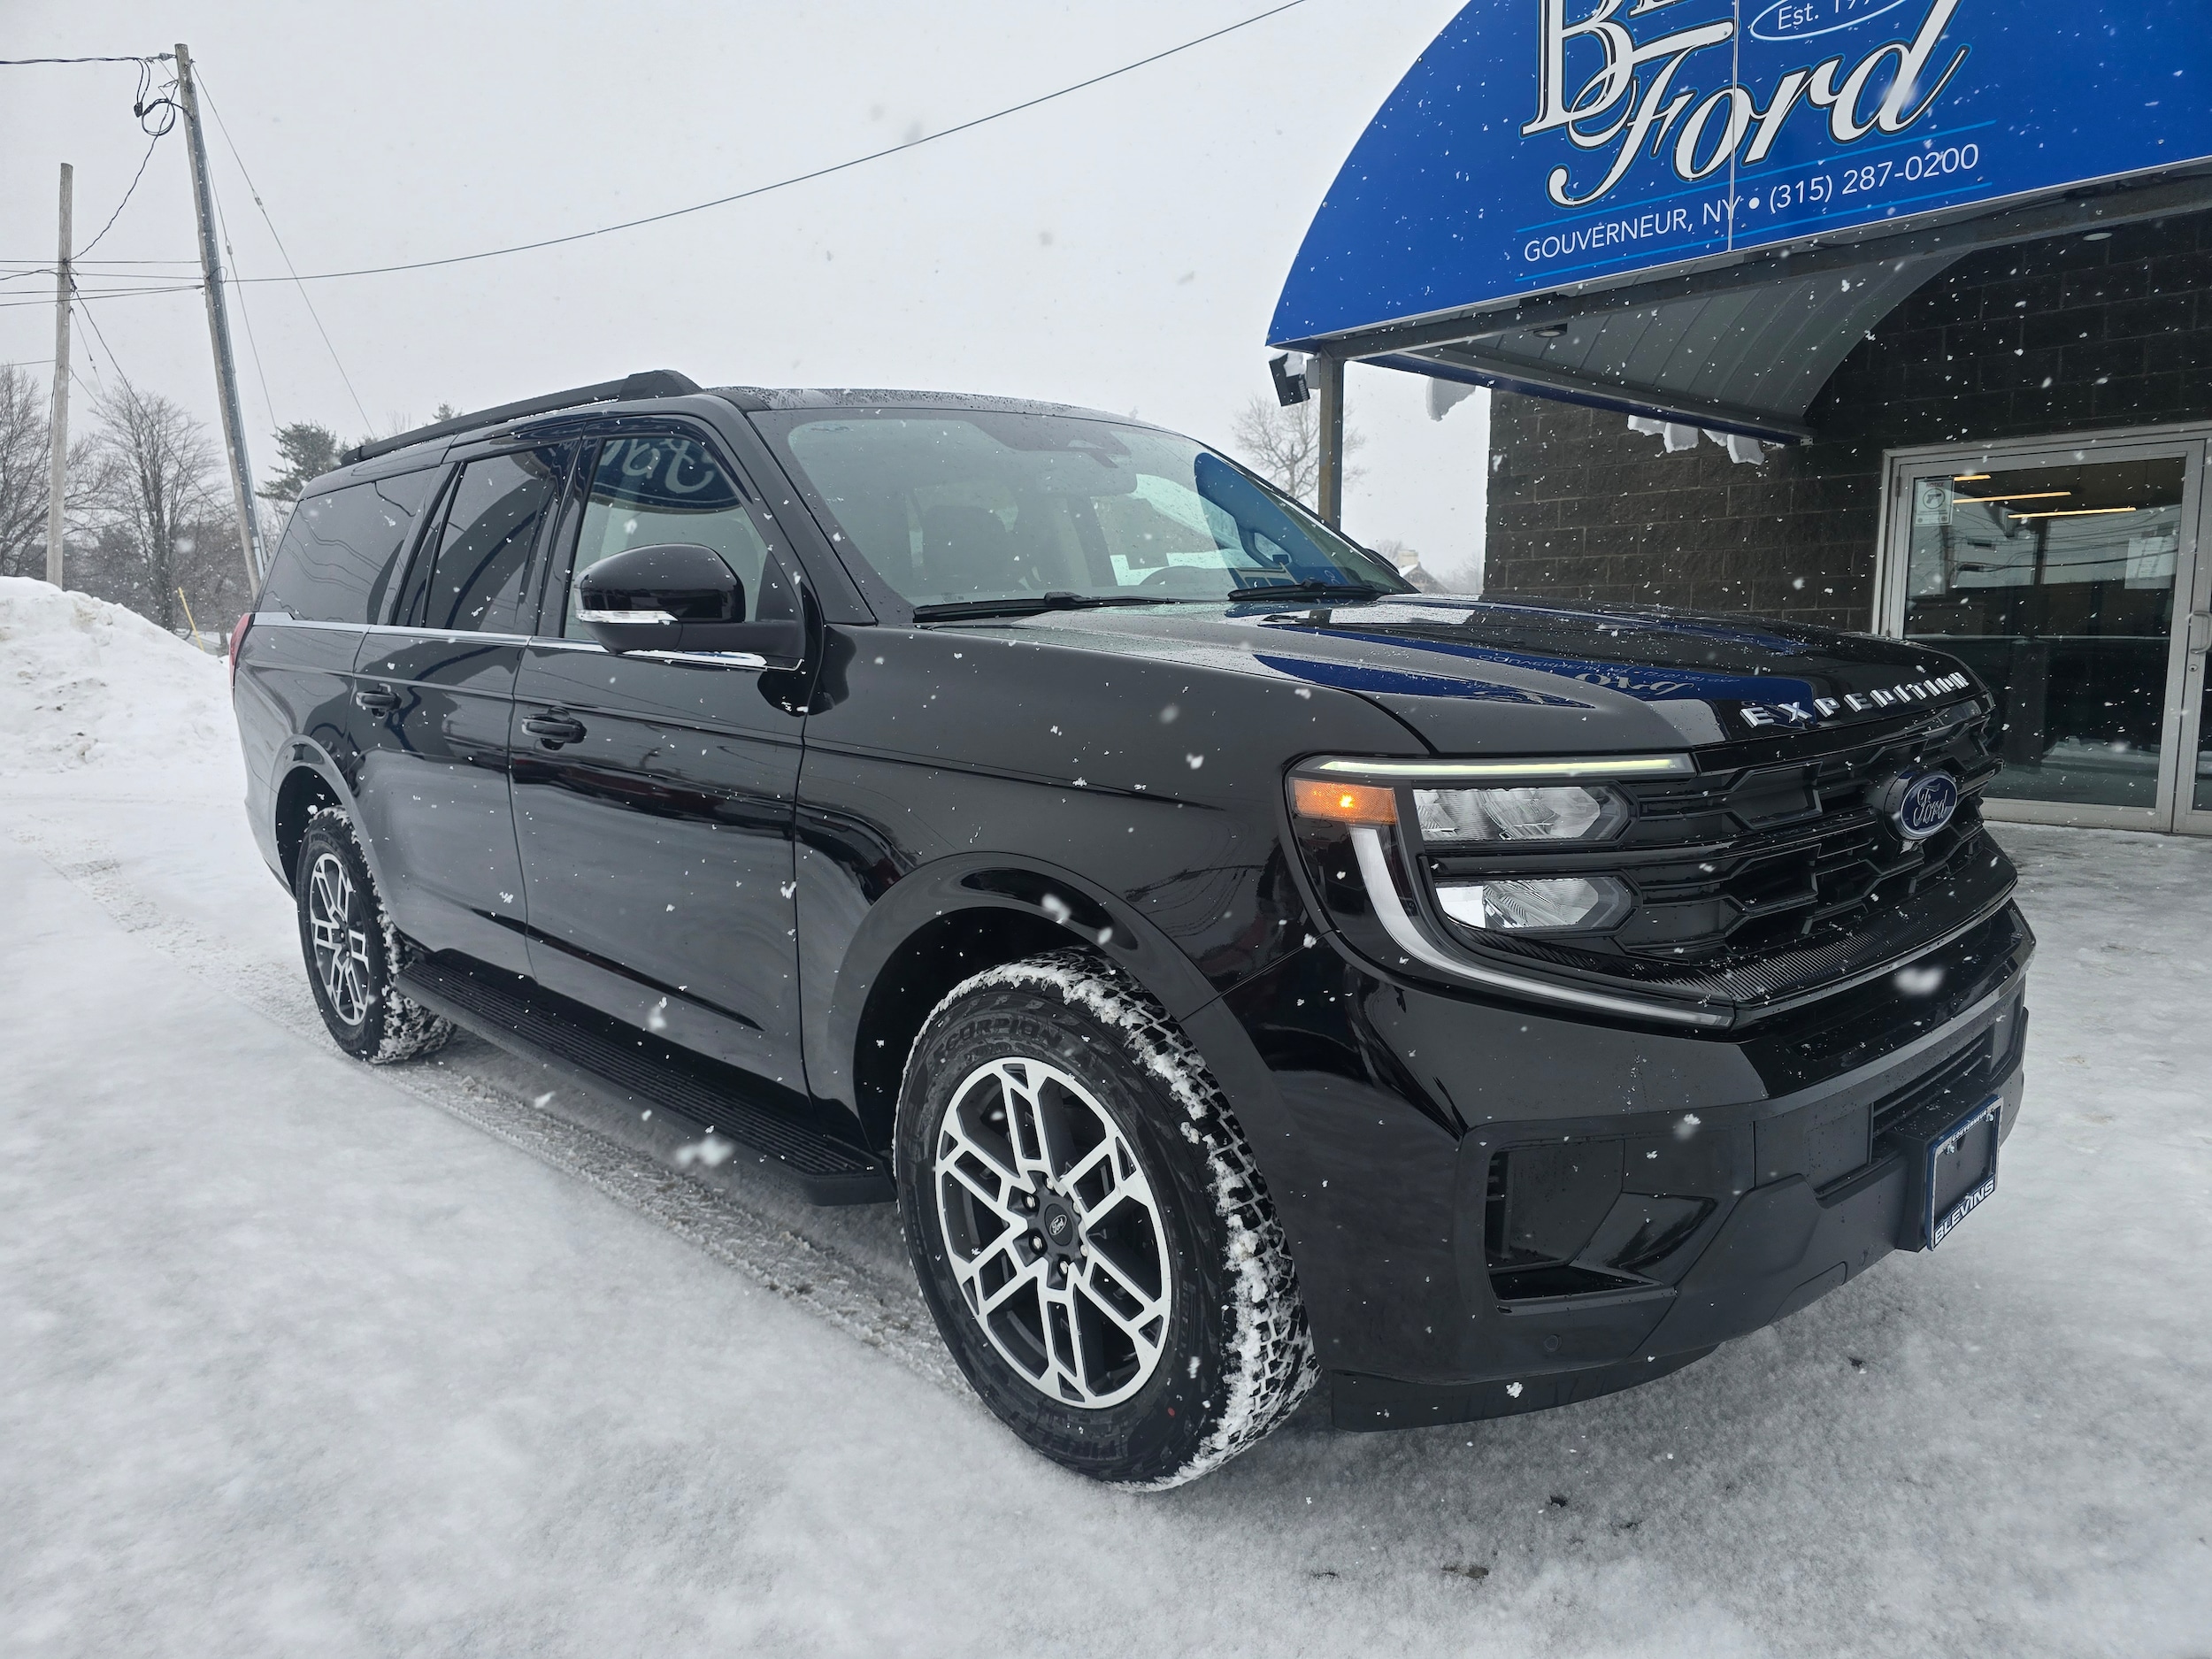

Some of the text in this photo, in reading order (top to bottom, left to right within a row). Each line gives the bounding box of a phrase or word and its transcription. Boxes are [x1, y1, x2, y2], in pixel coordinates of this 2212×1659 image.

[1778, 3, 1819, 30] Est.
[1548, 0, 1970, 206] Ford
[1524, 143, 1980, 263] GOUVERNEUR, NY (315) 287-0200
[1740, 672, 1970, 728] EXPEDITION
[1912, 785, 1949, 828] Ford
[1952, 1110, 1987, 1141] GOUVERNEUR
[1934, 1179, 1994, 1245] BLEVINS
